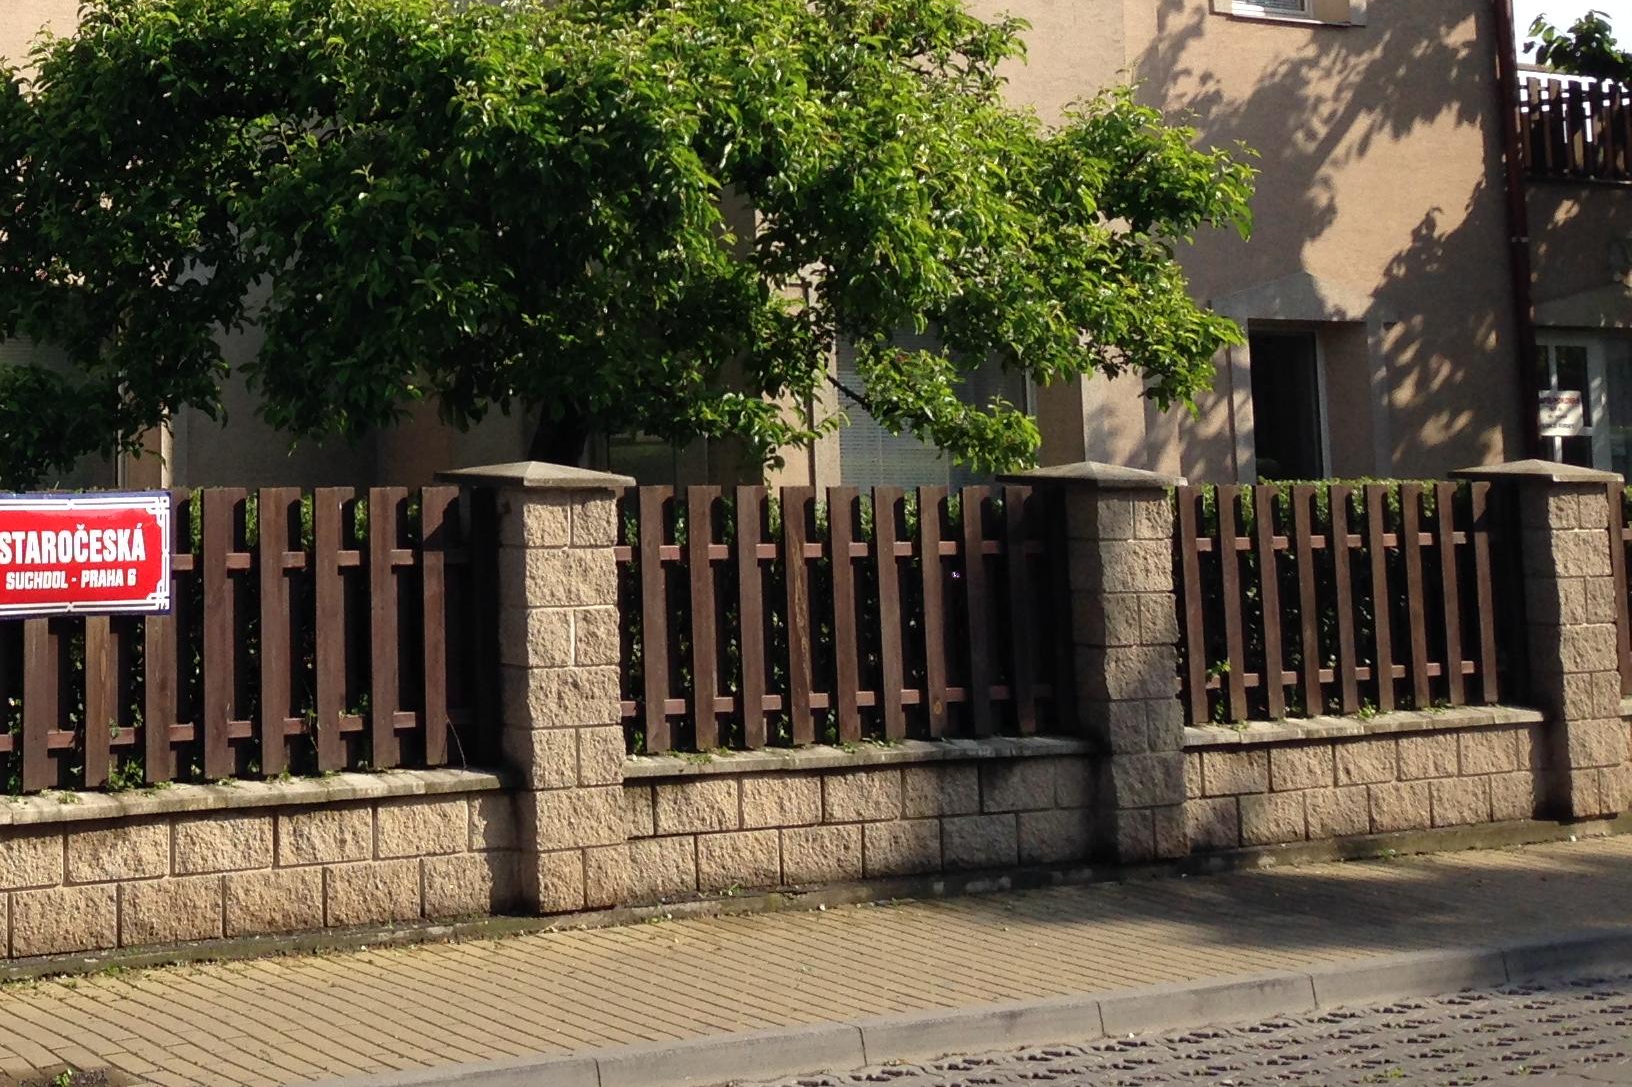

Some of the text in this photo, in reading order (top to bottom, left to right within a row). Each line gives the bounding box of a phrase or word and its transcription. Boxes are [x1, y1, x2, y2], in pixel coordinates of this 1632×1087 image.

[6, 569, 68, 590] SUCHDOL
[81, 569, 122, 588] PRAHA
[128, 569, 136, 586] 6
